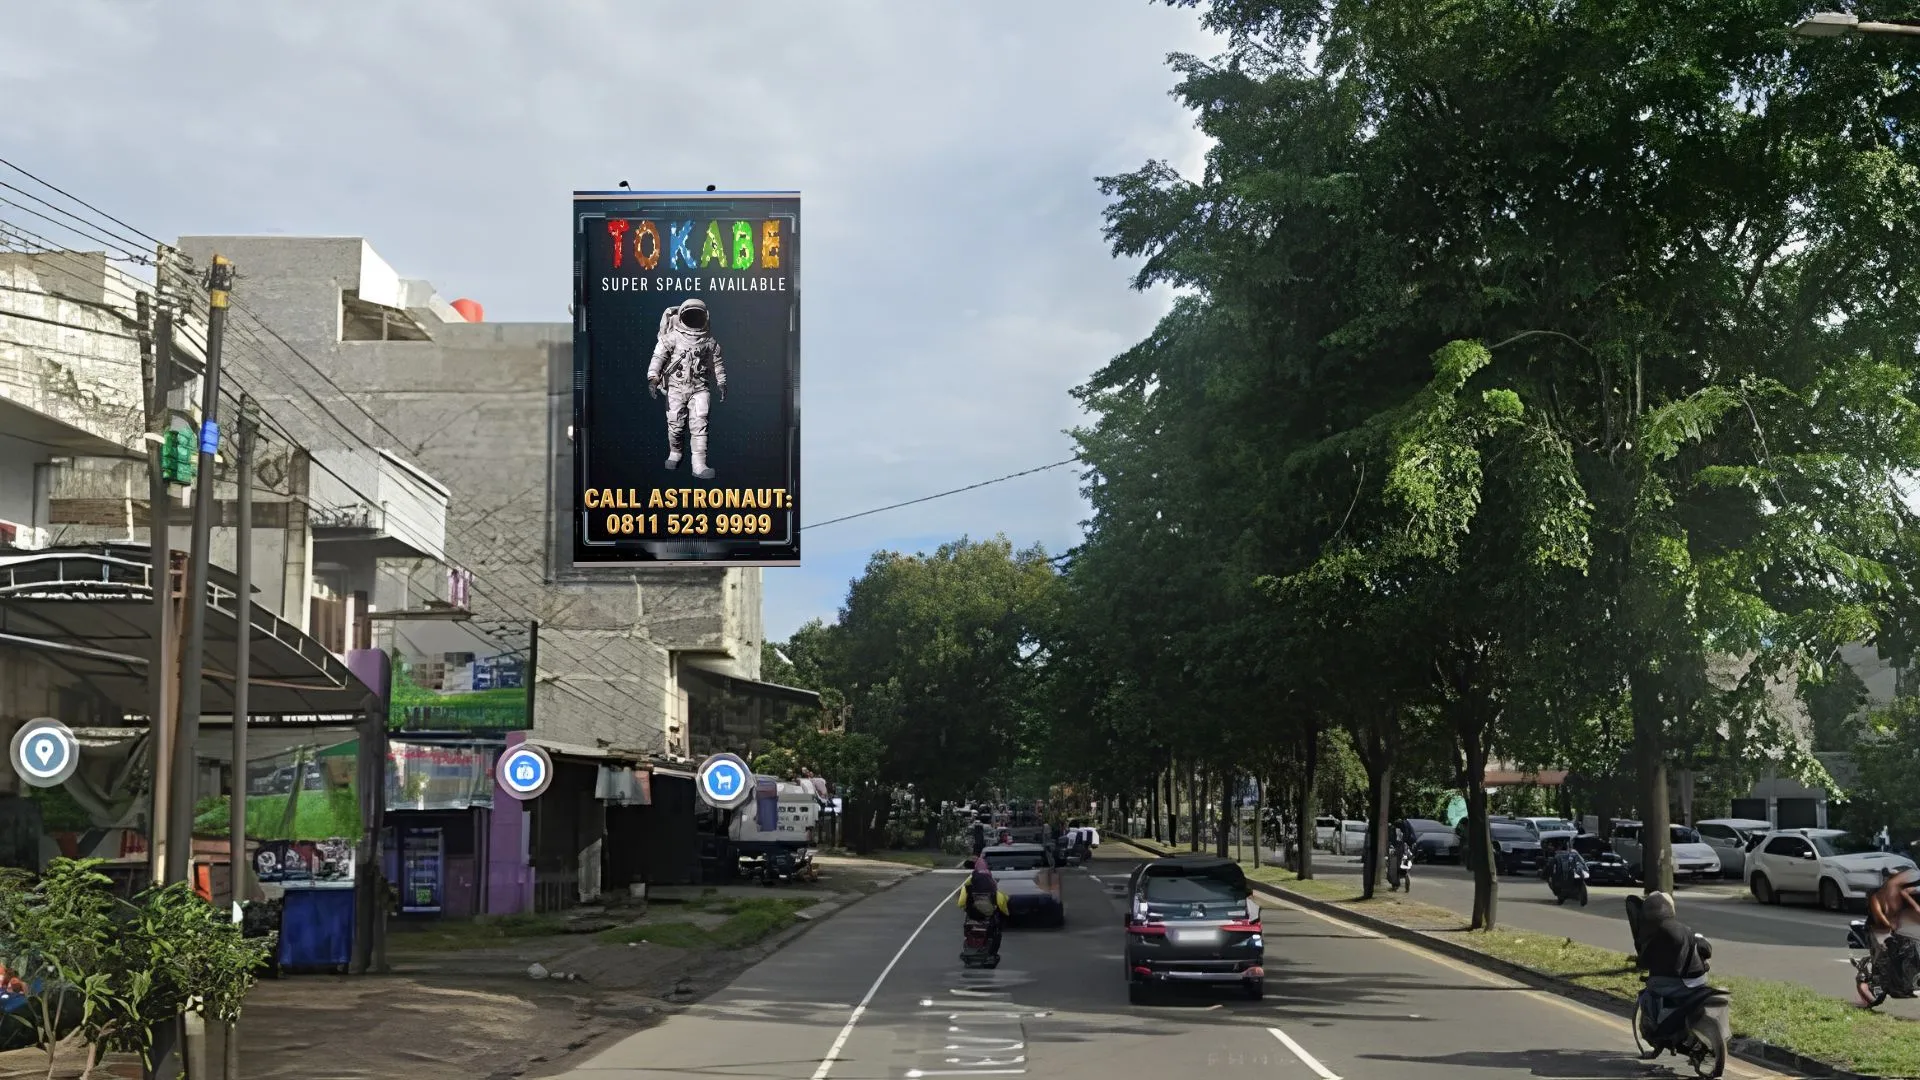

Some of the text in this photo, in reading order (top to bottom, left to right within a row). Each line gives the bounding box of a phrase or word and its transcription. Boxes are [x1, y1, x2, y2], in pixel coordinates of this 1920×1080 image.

[608, 219, 781, 270] TOKABE
[602, 278, 786, 291] SUPER SPACE AVAILABLE
[585, 488, 792, 508] CALL ASTRONAUT:
[607, 514, 771, 534] 0811 523 9999
